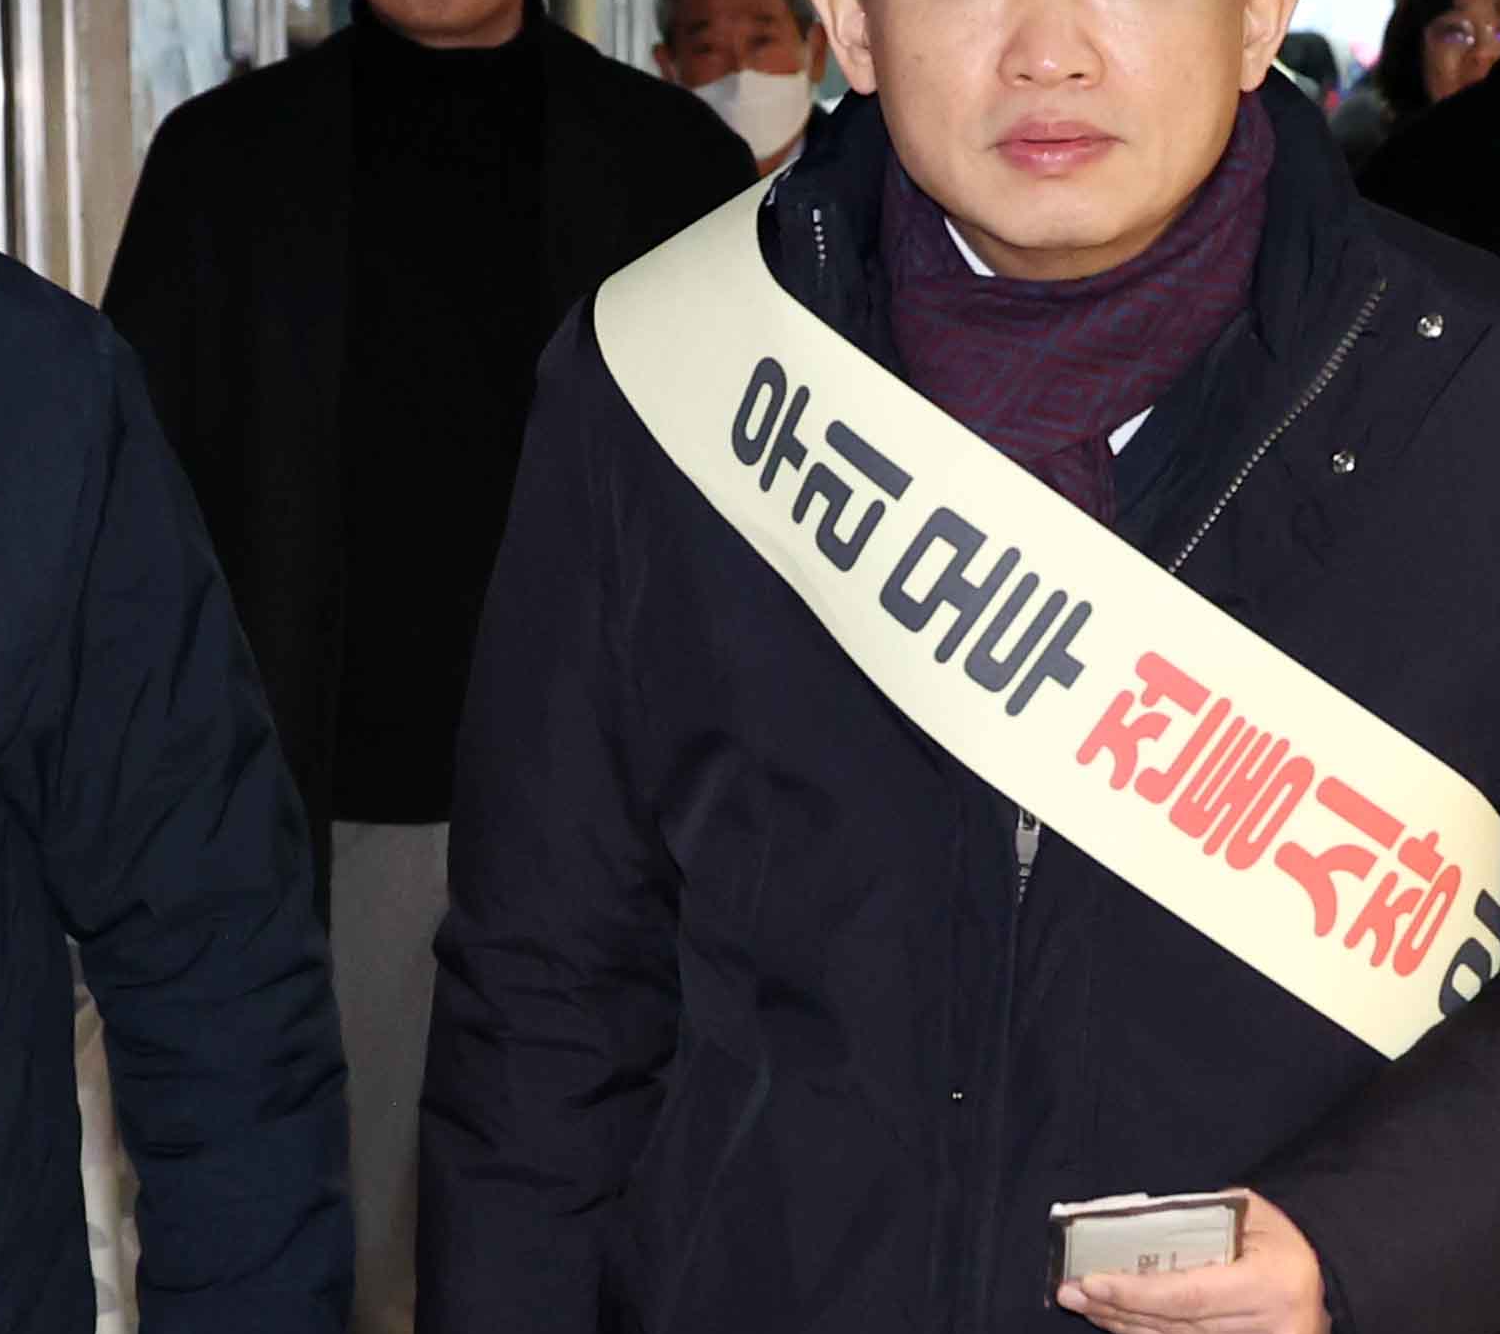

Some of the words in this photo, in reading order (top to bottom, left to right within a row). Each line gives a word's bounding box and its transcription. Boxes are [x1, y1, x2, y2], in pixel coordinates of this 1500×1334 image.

[731, 355, 913, 573] 우리
[879, 506, 1094, 717] 모두
[1075, 649, 1464, 978] 전통시장
